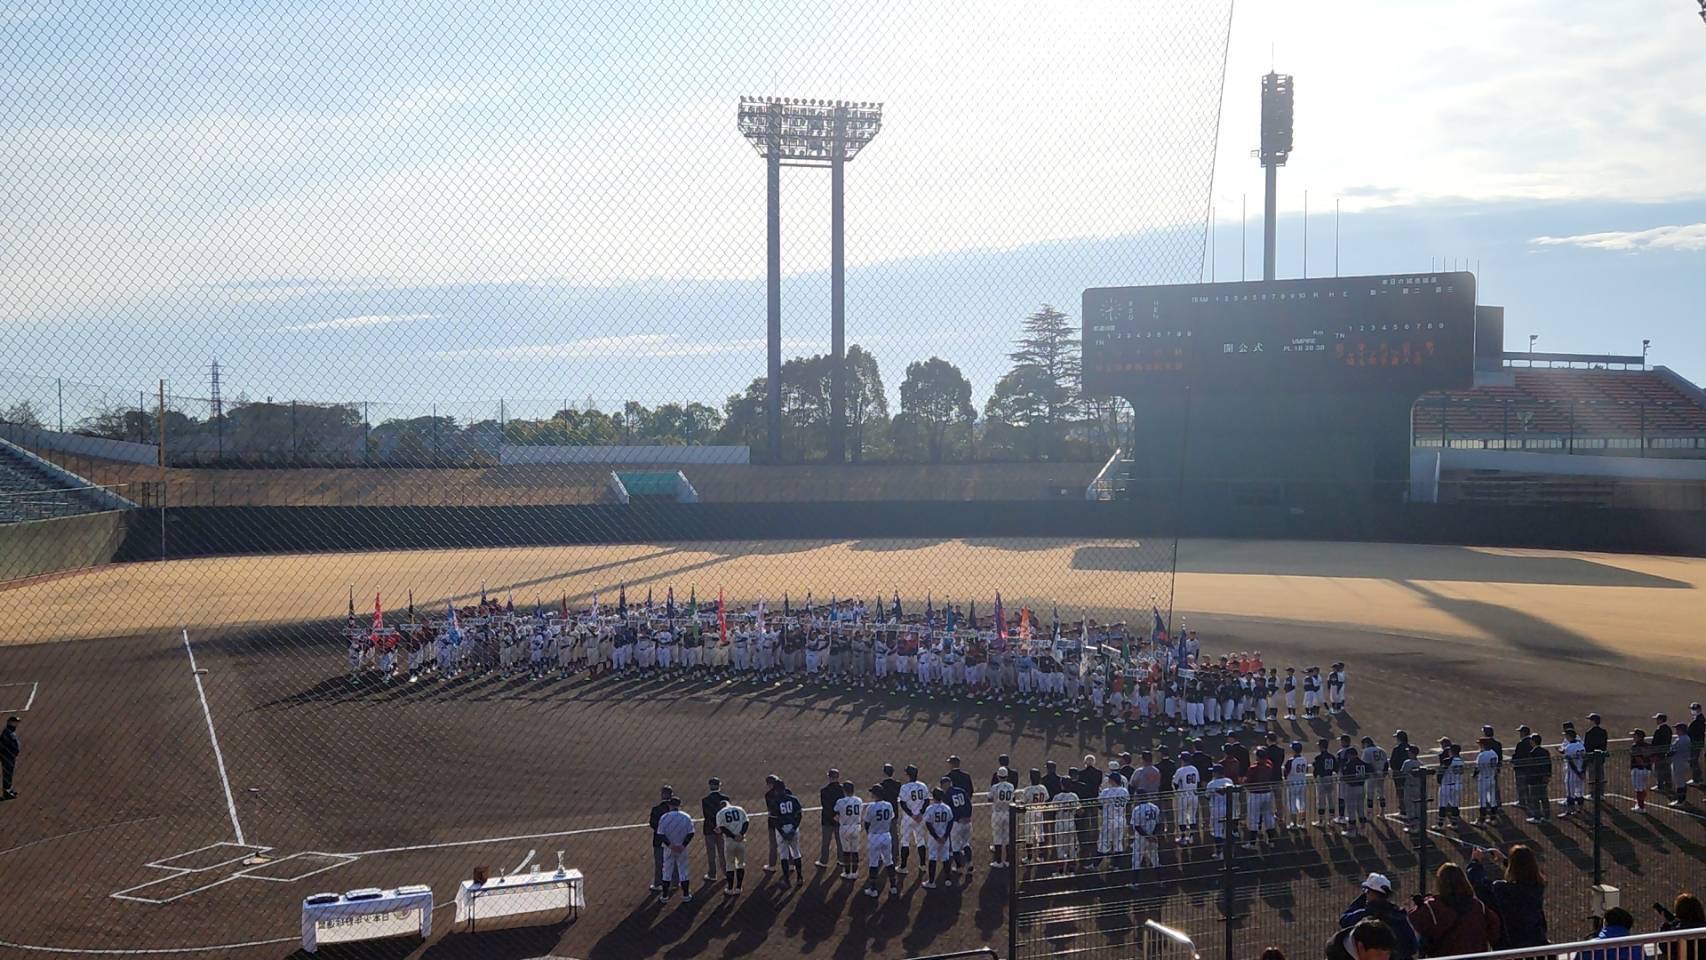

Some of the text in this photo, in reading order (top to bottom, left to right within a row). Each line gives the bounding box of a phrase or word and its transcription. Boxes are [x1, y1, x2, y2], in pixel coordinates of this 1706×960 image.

[1296, 763, 1306, 773] 60
[1186, 773, 1196, 784] 60
[910, 789, 923, 802] 60
[999, 790, 1012, 802] 60
[779, 801, 793, 815] 60
[845, 804, 859, 816] 60
[725, 810, 740, 823] 60
[876, 809, 890, 821] 50
[934, 811, 947, 823] 50
